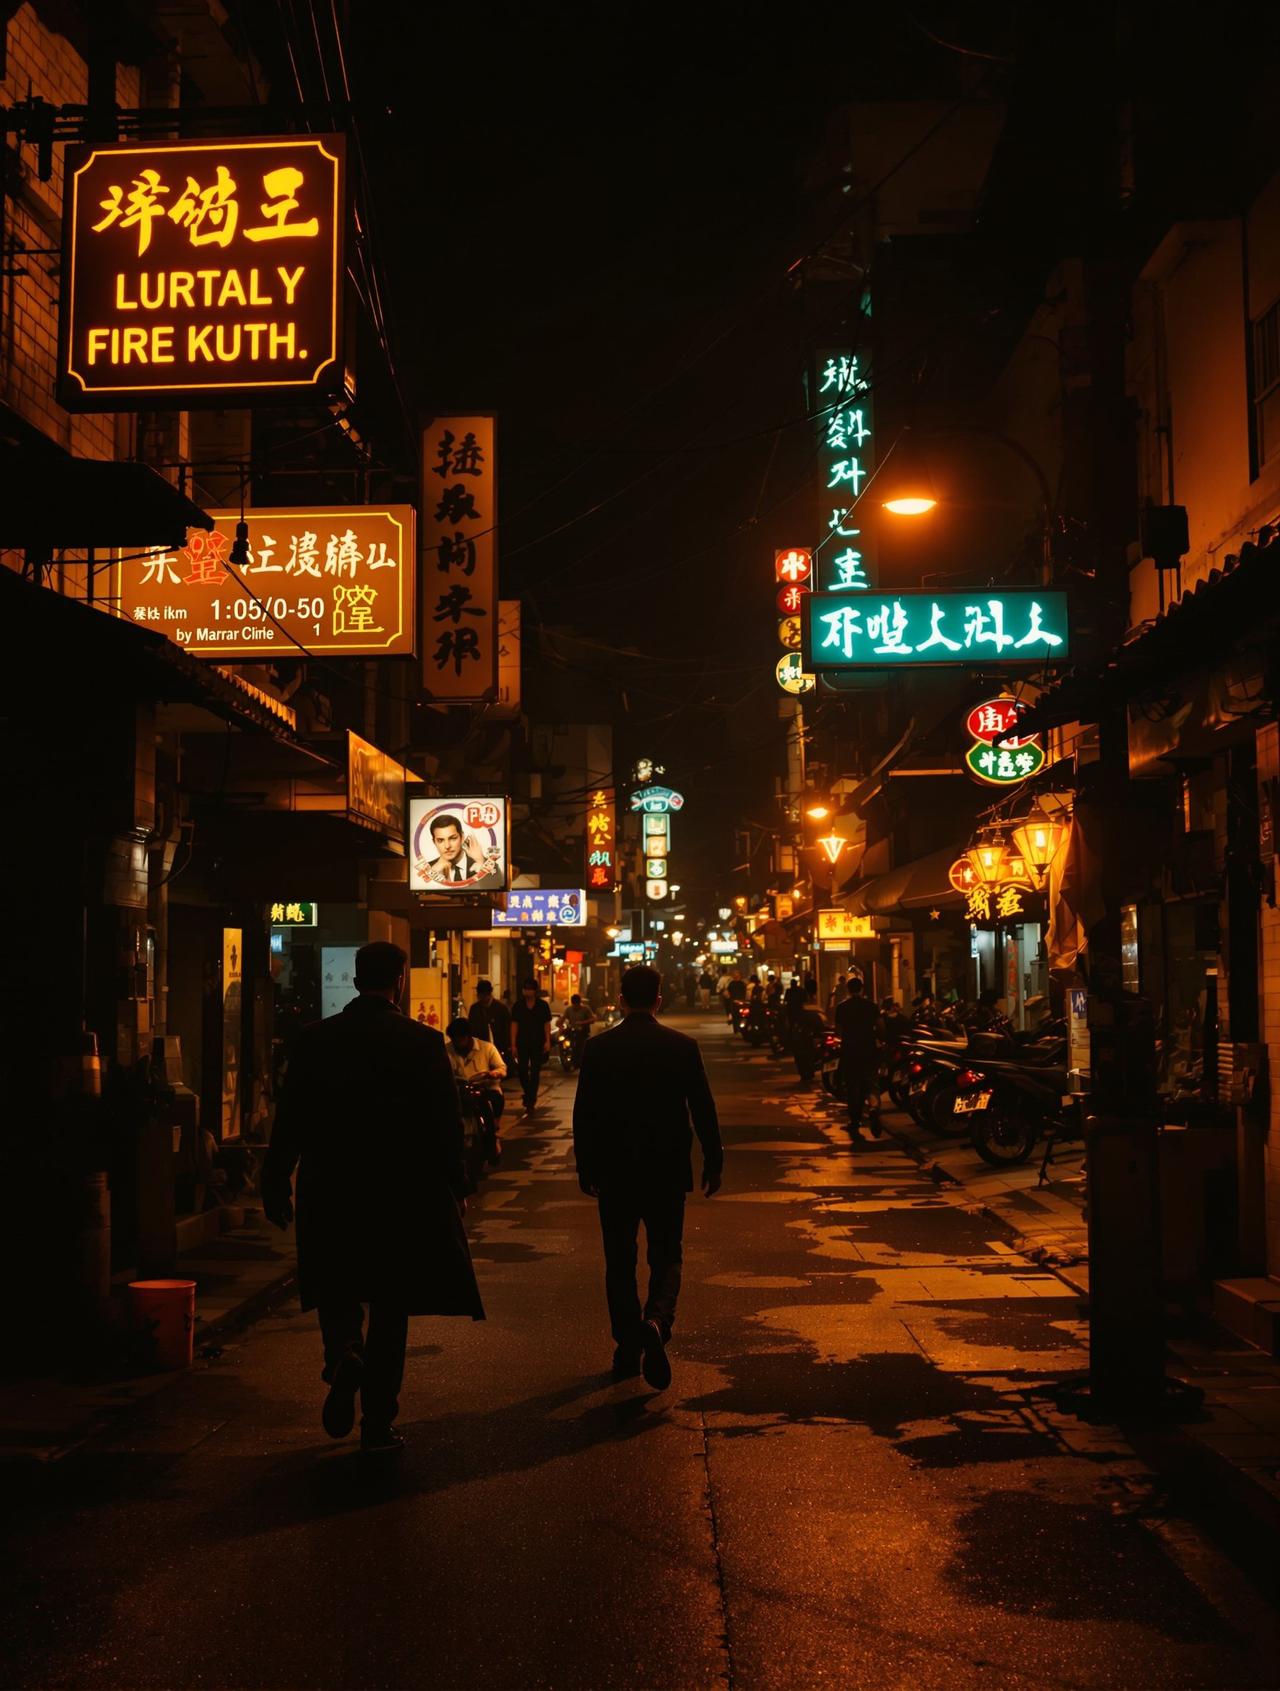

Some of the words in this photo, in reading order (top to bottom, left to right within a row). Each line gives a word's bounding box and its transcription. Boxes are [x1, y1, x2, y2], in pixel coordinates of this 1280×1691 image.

[87, 326, 175, 366] FIRE
[188, 322, 308, 363] KUTH.
[210, 597, 325, 623] 1:05/0-50
[176, 628, 193, 644] by
[196, 627, 240, 641] Marrar
